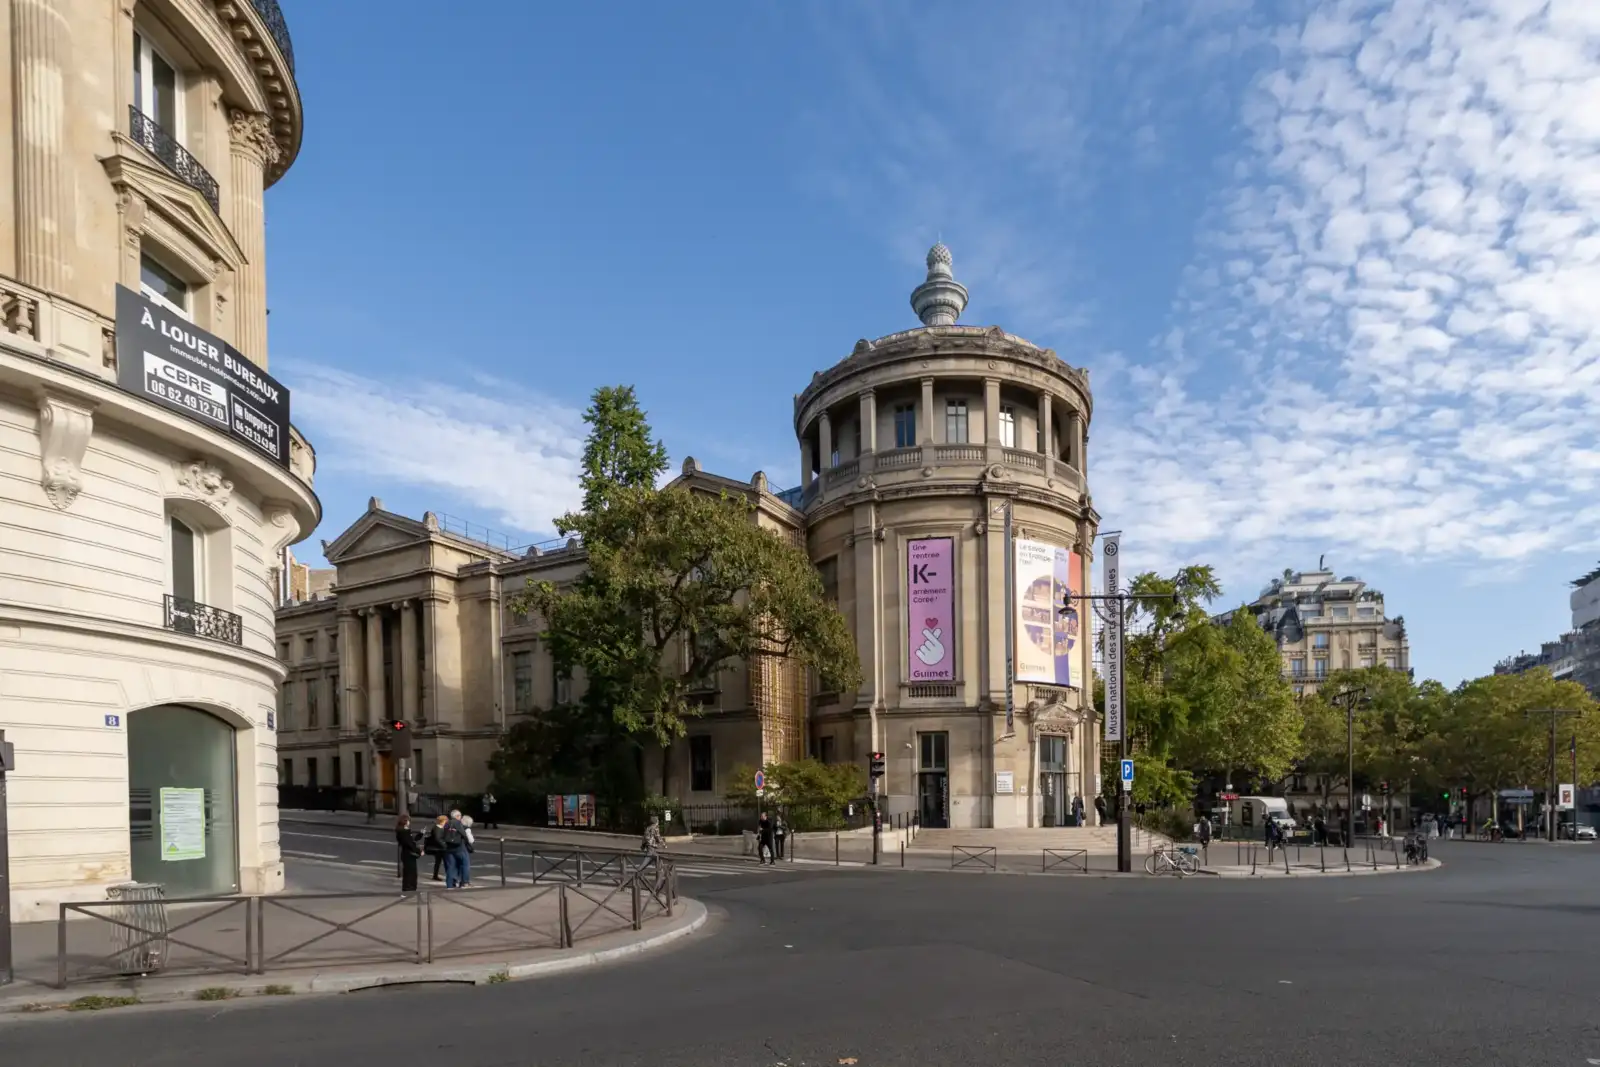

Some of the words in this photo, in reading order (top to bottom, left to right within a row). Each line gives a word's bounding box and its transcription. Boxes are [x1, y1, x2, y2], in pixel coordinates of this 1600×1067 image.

[141, 306, 155, 330] À
[161, 320, 219, 363] LOUER
[223, 353, 279, 404] BUREAUX
[162, 364, 213, 396] CBRE
[151, 379, 166, 396] 06
[168, 386, 183, 403] 62
[184, 394, 198, 409] 49
[199, 400, 211, 415] 12
[211, 404, 225, 421] 70
[244, 425, 253, 438] 33
[253, 430, 261, 443] 13
[913, 563, 937, 584] K-
[1107, 568, 1119, 618] asiaiques
[1108, 620, 1117, 641] arts
[1107, 643, 1117, 660] des
[913, 669, 949, 678] Guimet
[1107, 662, 1117, 702] national
[108, 715, 116, 726] 8
[1108, 703, 1118, 735] Musée
[1125, 764, 1131, 777] P
